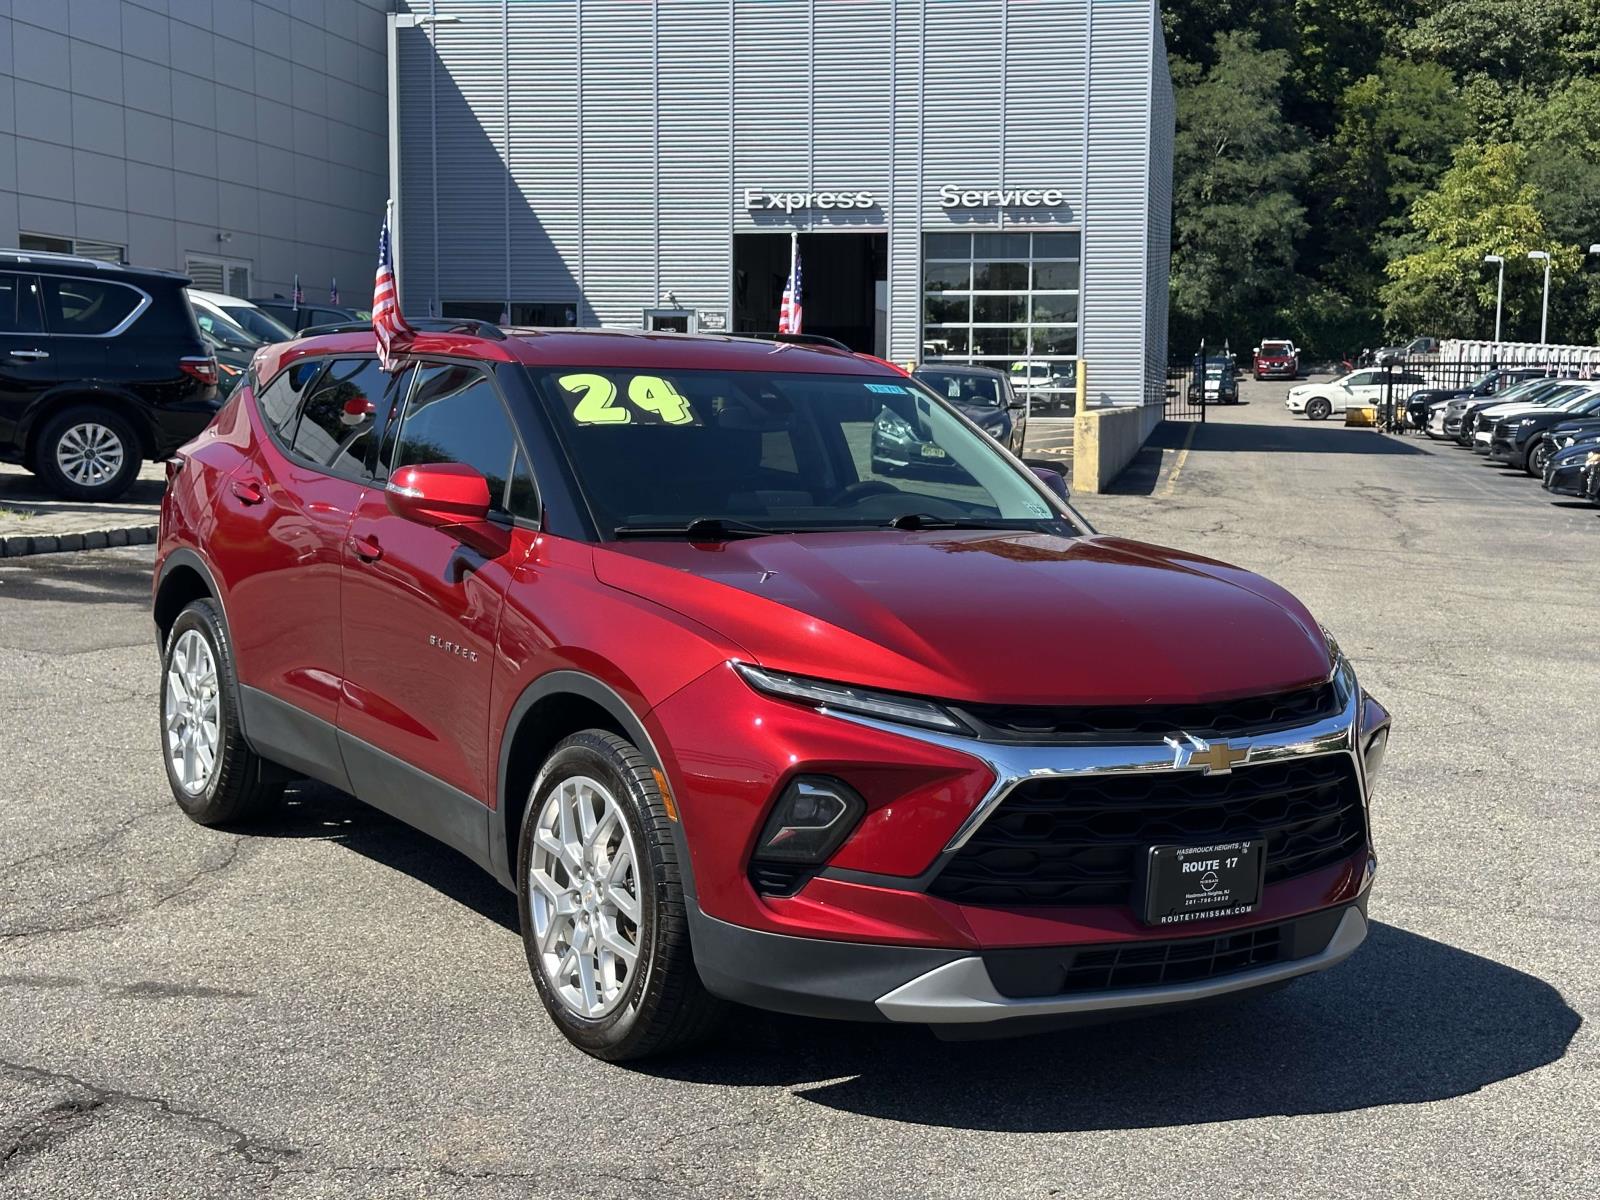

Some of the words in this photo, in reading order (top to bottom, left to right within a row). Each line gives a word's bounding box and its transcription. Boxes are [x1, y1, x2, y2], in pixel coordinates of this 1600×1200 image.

[744, 187, 874, 214] Express
[939, 184, 1064, 208] Service
[558, 373, 694, 425] 24
[429, 634, 478, 662] BLAZER
[1176, 845, 1214, 856] HASBROUCK
[1242, 841, 1251, 849] NJ
[1182, 860, 1220, 873] ROUTE
[1225, 858, 1239, 868] 17
[1161, 905, 1252, 924] ROUTE17NISSAN.COM
